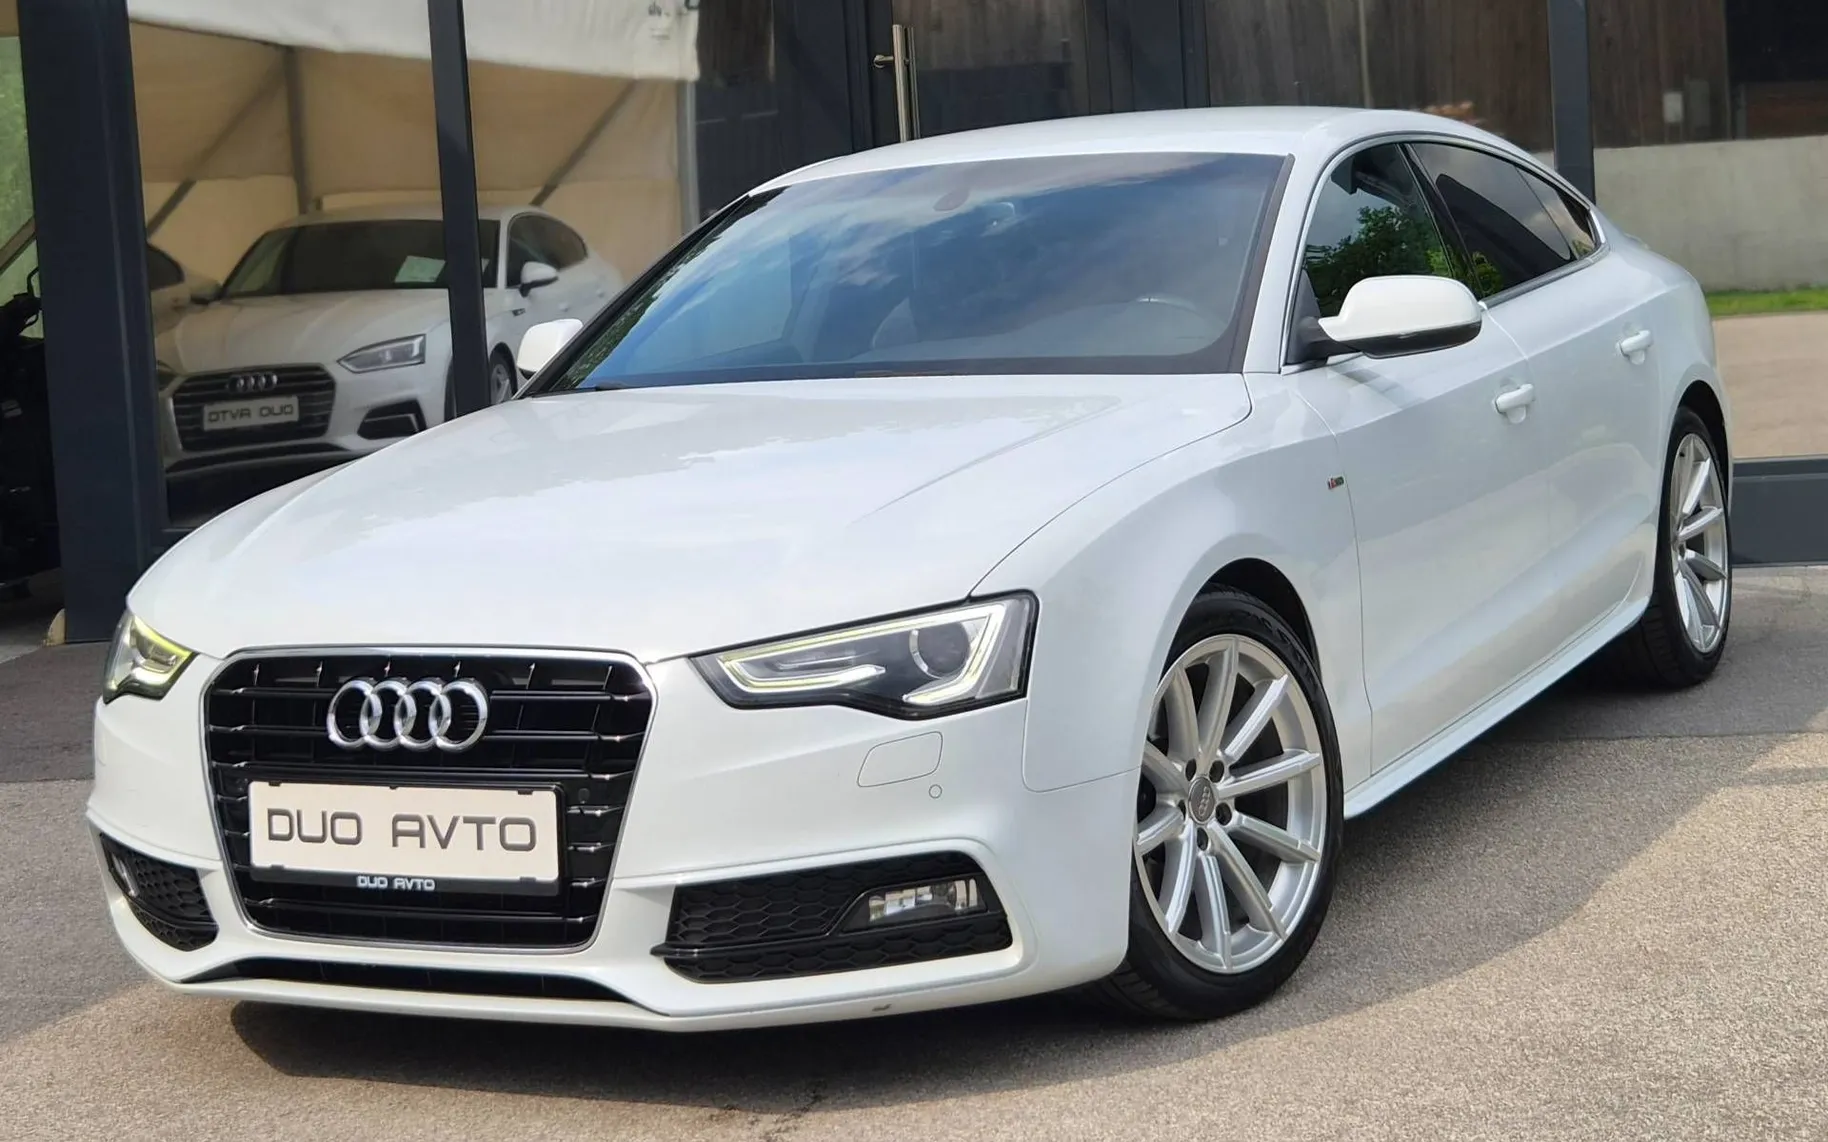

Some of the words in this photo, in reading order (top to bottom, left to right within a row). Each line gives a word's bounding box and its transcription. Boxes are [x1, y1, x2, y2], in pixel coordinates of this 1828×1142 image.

[267, 808, 362, 845] DUO
[391, 813, 537, 852] AVTO
[356, 875, 388, 889] DUO
[393, 877, 436, 891] AVTO
